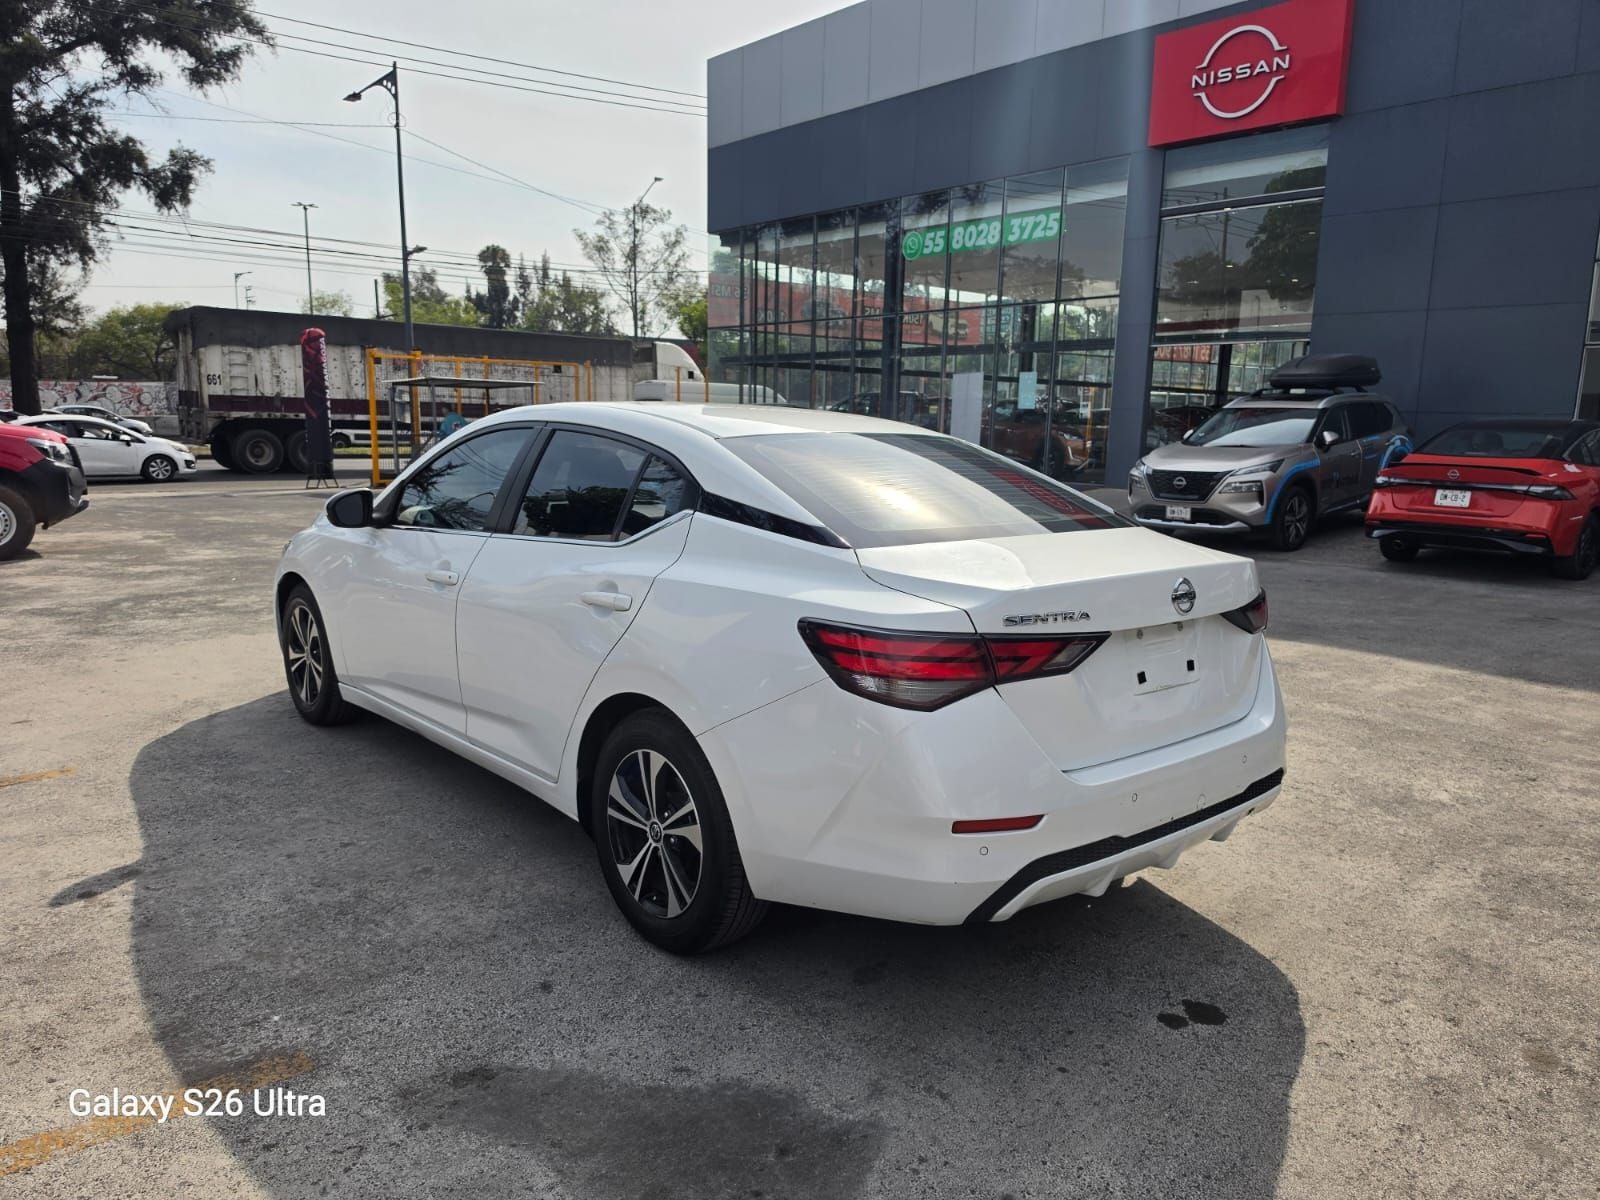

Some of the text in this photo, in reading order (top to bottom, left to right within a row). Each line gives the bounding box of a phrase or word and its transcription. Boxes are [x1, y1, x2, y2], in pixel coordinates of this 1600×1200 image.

[1192, 54, 1291, 88] NISSAN
[922, 212, 1061, 254] 55 8028 3725
[206, 374, 222, 385] 661
[1002, 610, 1091, 627] SENTRA
